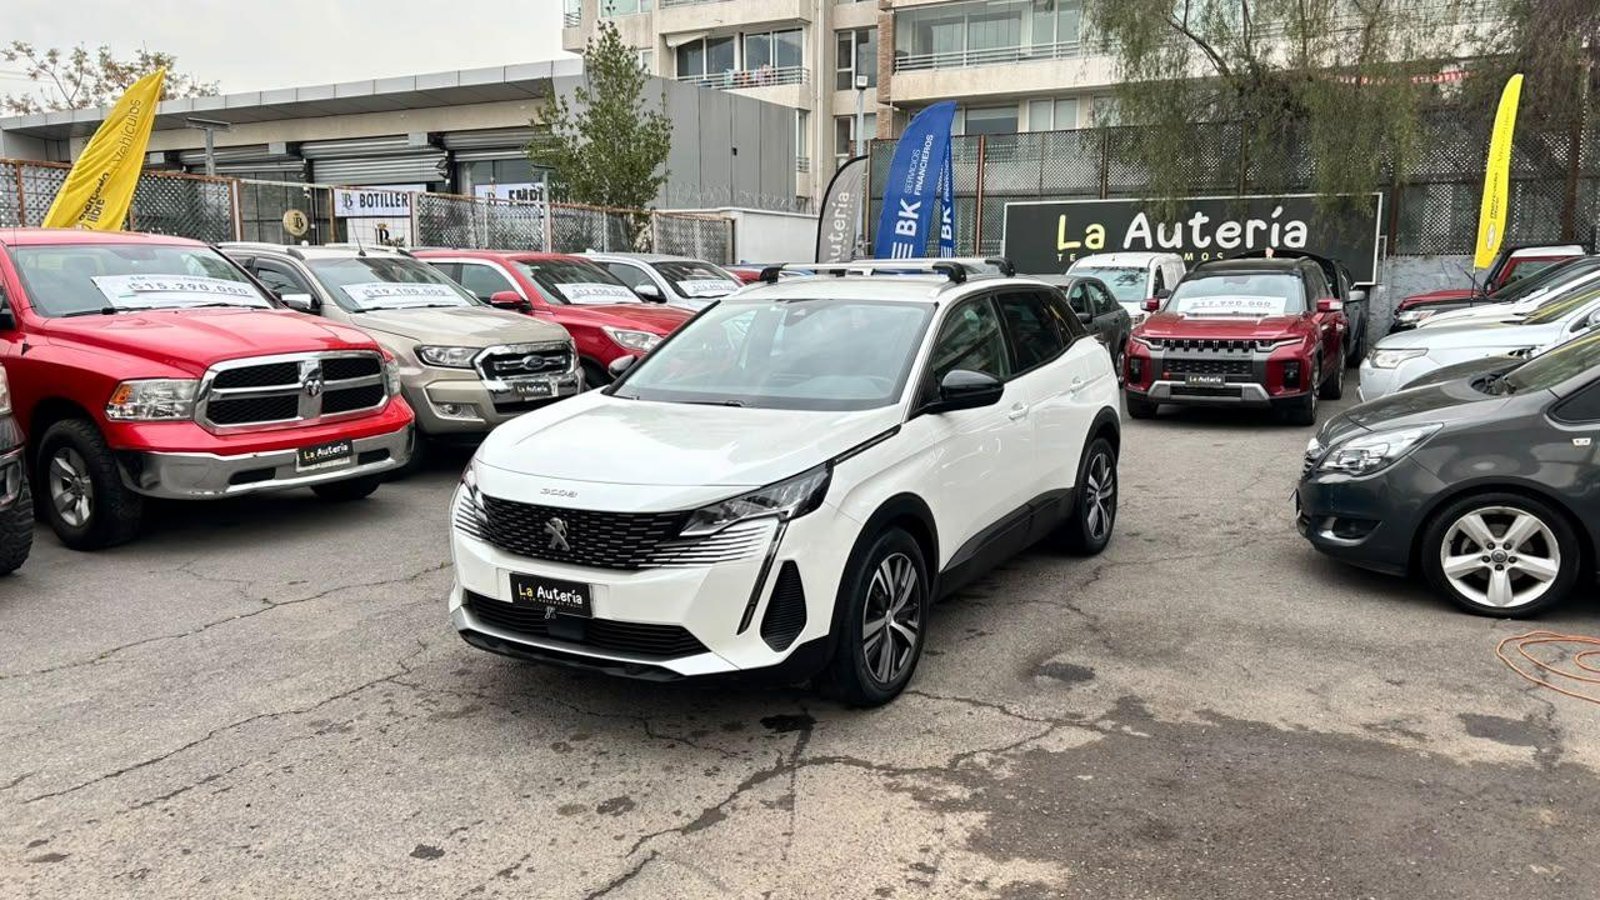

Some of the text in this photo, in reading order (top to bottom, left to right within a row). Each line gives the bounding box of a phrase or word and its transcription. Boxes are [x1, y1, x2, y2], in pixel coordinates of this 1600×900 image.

[904, 149, 920, 194] SERVICIOS
[914, 134, 933, 195] FINANCIEROS
[86, 199, 105, 222] libre
[360, 193, 408, 208] BOTILLER
[895, 198, 921, 237] BK
[941, 204, 951, 240] BK
[1057, 206, 1308, 250] La Autería
[304, 450, 315, 460] La
[518, 582, 533, 597] La
[537, 585, 582, 605] Autería
